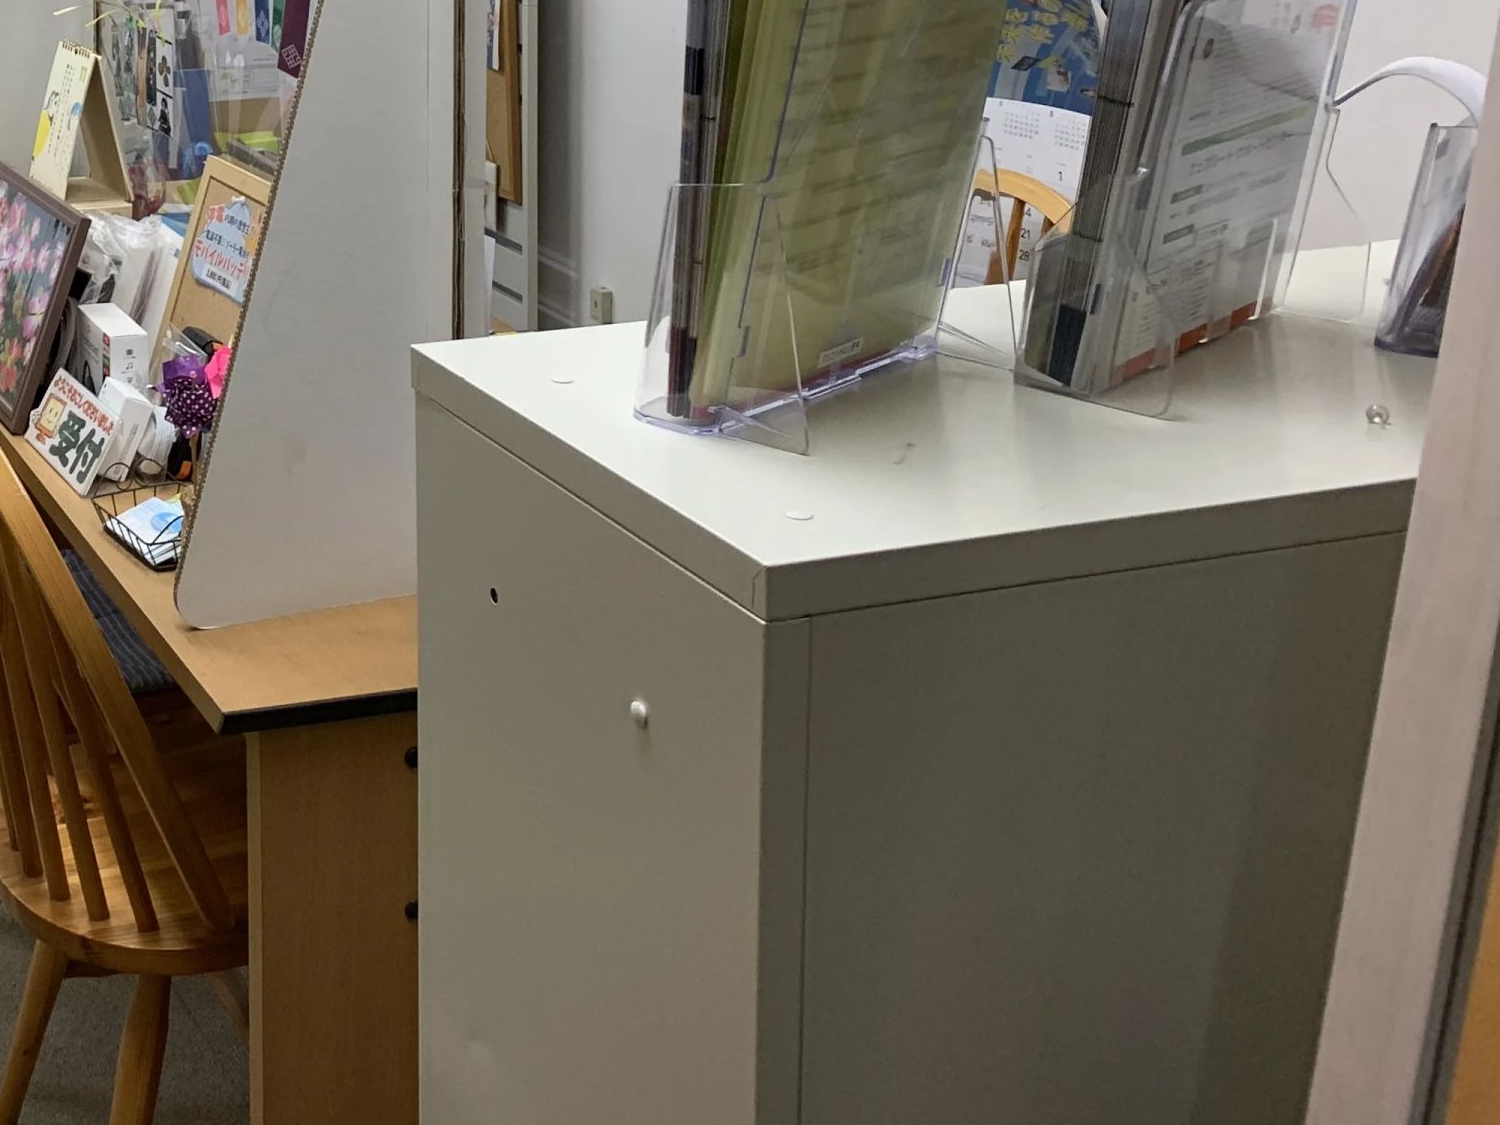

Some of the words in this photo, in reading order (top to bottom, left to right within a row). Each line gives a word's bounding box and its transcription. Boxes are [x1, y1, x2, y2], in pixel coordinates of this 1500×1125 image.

[1020, 228, 1031, 239] 21
[1018, 249, 1030, 261] 28
[48, 410, 105, 484] 受付
